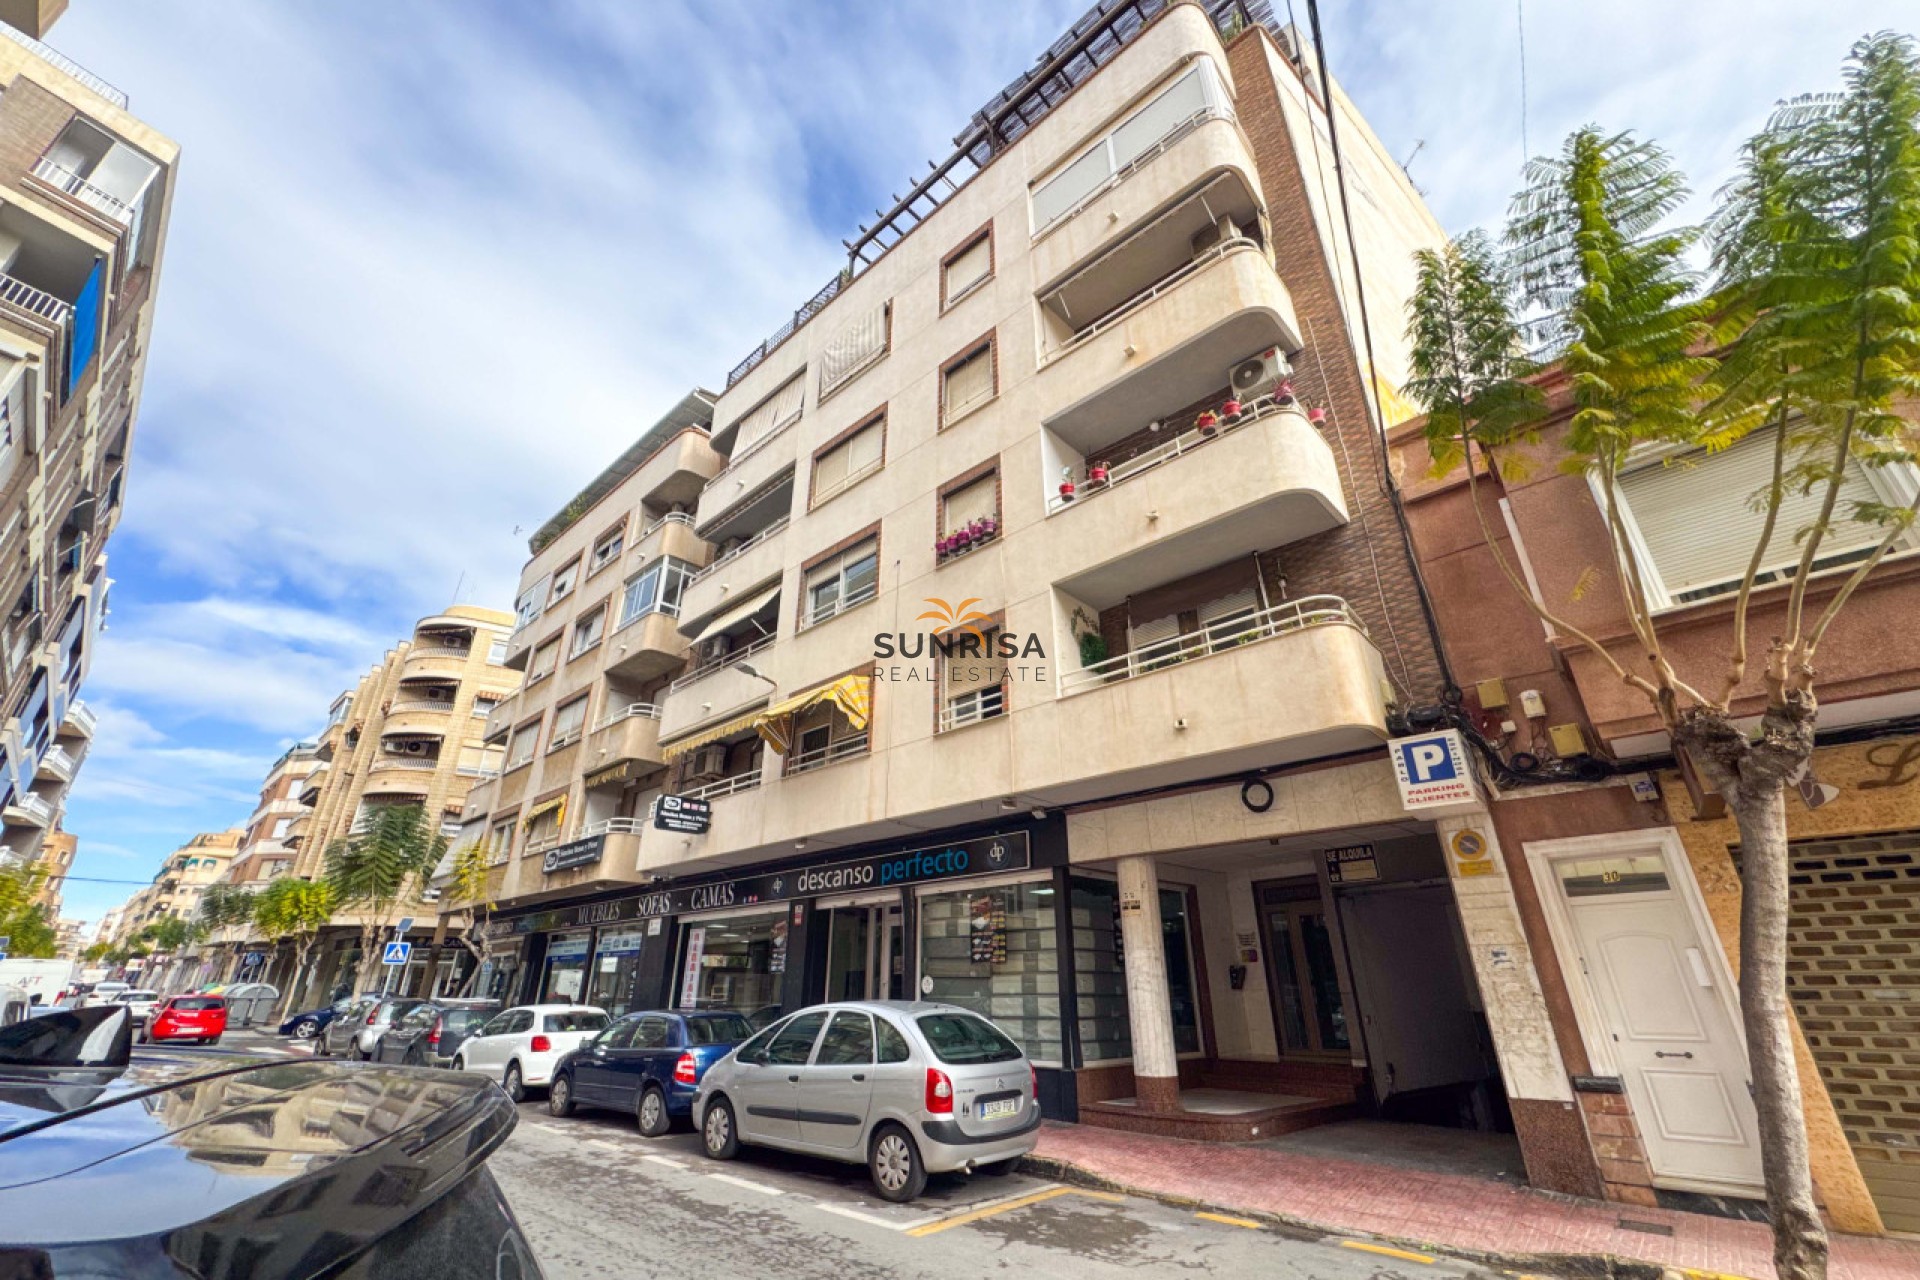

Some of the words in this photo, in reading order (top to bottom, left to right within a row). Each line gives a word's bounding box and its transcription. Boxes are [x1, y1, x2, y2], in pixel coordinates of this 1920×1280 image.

[1411, 744, 1445, 780] P
[1407, 791, 1470, 804] CLIENTES
[1408, 783, 1464, 796] PARKING
[1339, 847, 1373, 861] ALQUILA
[797, 863, 874, 892] descanso
[881, 849, 969, 886] perfecto
[637, 892, 671, 917] SOFAS
[691, 881, 736, 910] CAMAS
